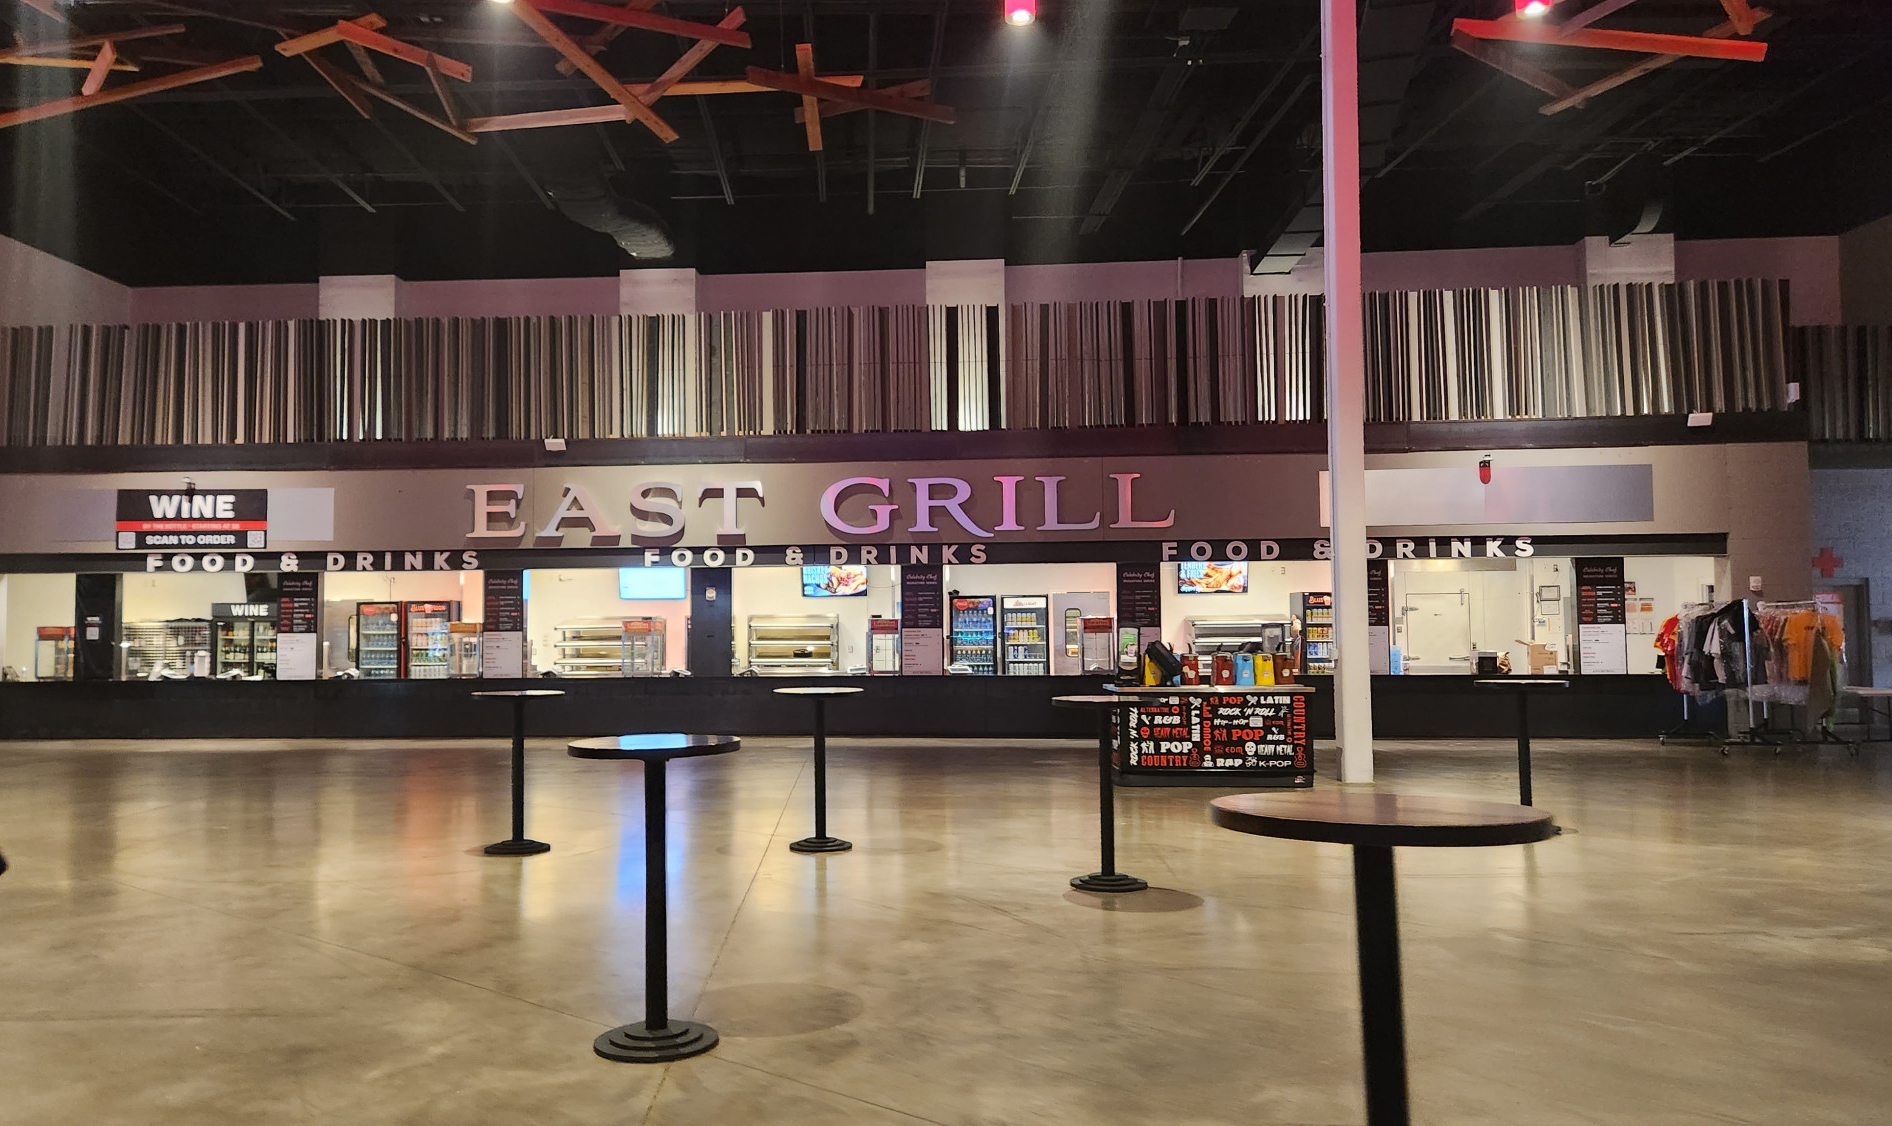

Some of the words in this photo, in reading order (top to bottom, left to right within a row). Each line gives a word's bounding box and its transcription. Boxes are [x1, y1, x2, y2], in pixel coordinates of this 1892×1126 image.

[149, 494, 235, 518] WINE
[466, 480, 764, 538] EAST
[820, 473, 1175, 538] GRILL
[145, 535, 179, 545] SCAN
[180, 535, 197, 545] TO
[197, 534, 236, 545] ORDER
[1162, 540, 1281, 562] FOOD
[1313, 539, 1332, 560] &
[1366, 536, 1535, 560] DRINKS
[147, 553, 255, 573] FOOD
[280, 552, 299, 573] &
[326, 550, 479, 571] DRINKS
[644, 547, 755, 568] FOOD
[785, 546, 804, 566] &
[829, 544, 988, 565] DRINKS
[230, 604, 269, 616] WINE
[1222, 696, 1244, 705] POP
[1260, 695, 1291, 704] LATIN
[1129, 706, 1139, 728] ROLL
[1217, 707, 1242, 716] ROCK
[1254, 707, 1276, 716] ROLL
[1153, 715, 1181, 725] R&B
[1191, 710, 1201, 742] LATIN
[1213, 718, 1249, 726] HIP-HOP
[1293, 695, 1306, 745] COUNTRY
[1153, 727, 1171, 738] HEAVY
[1172, 727, 1190, 738] METAL
[1231, 728, 1265, 741] POP
[1159, 741, 1193, 753] POP
[1257, 744, 1275, 756] HEAVY
[1276, 744, 1295, 756] METAL
[1129, 741, 1139, 767] ROCK
[1141, 755, 1188, 767] COUNTRY
[1215, 758, 1243, 767] RAP
